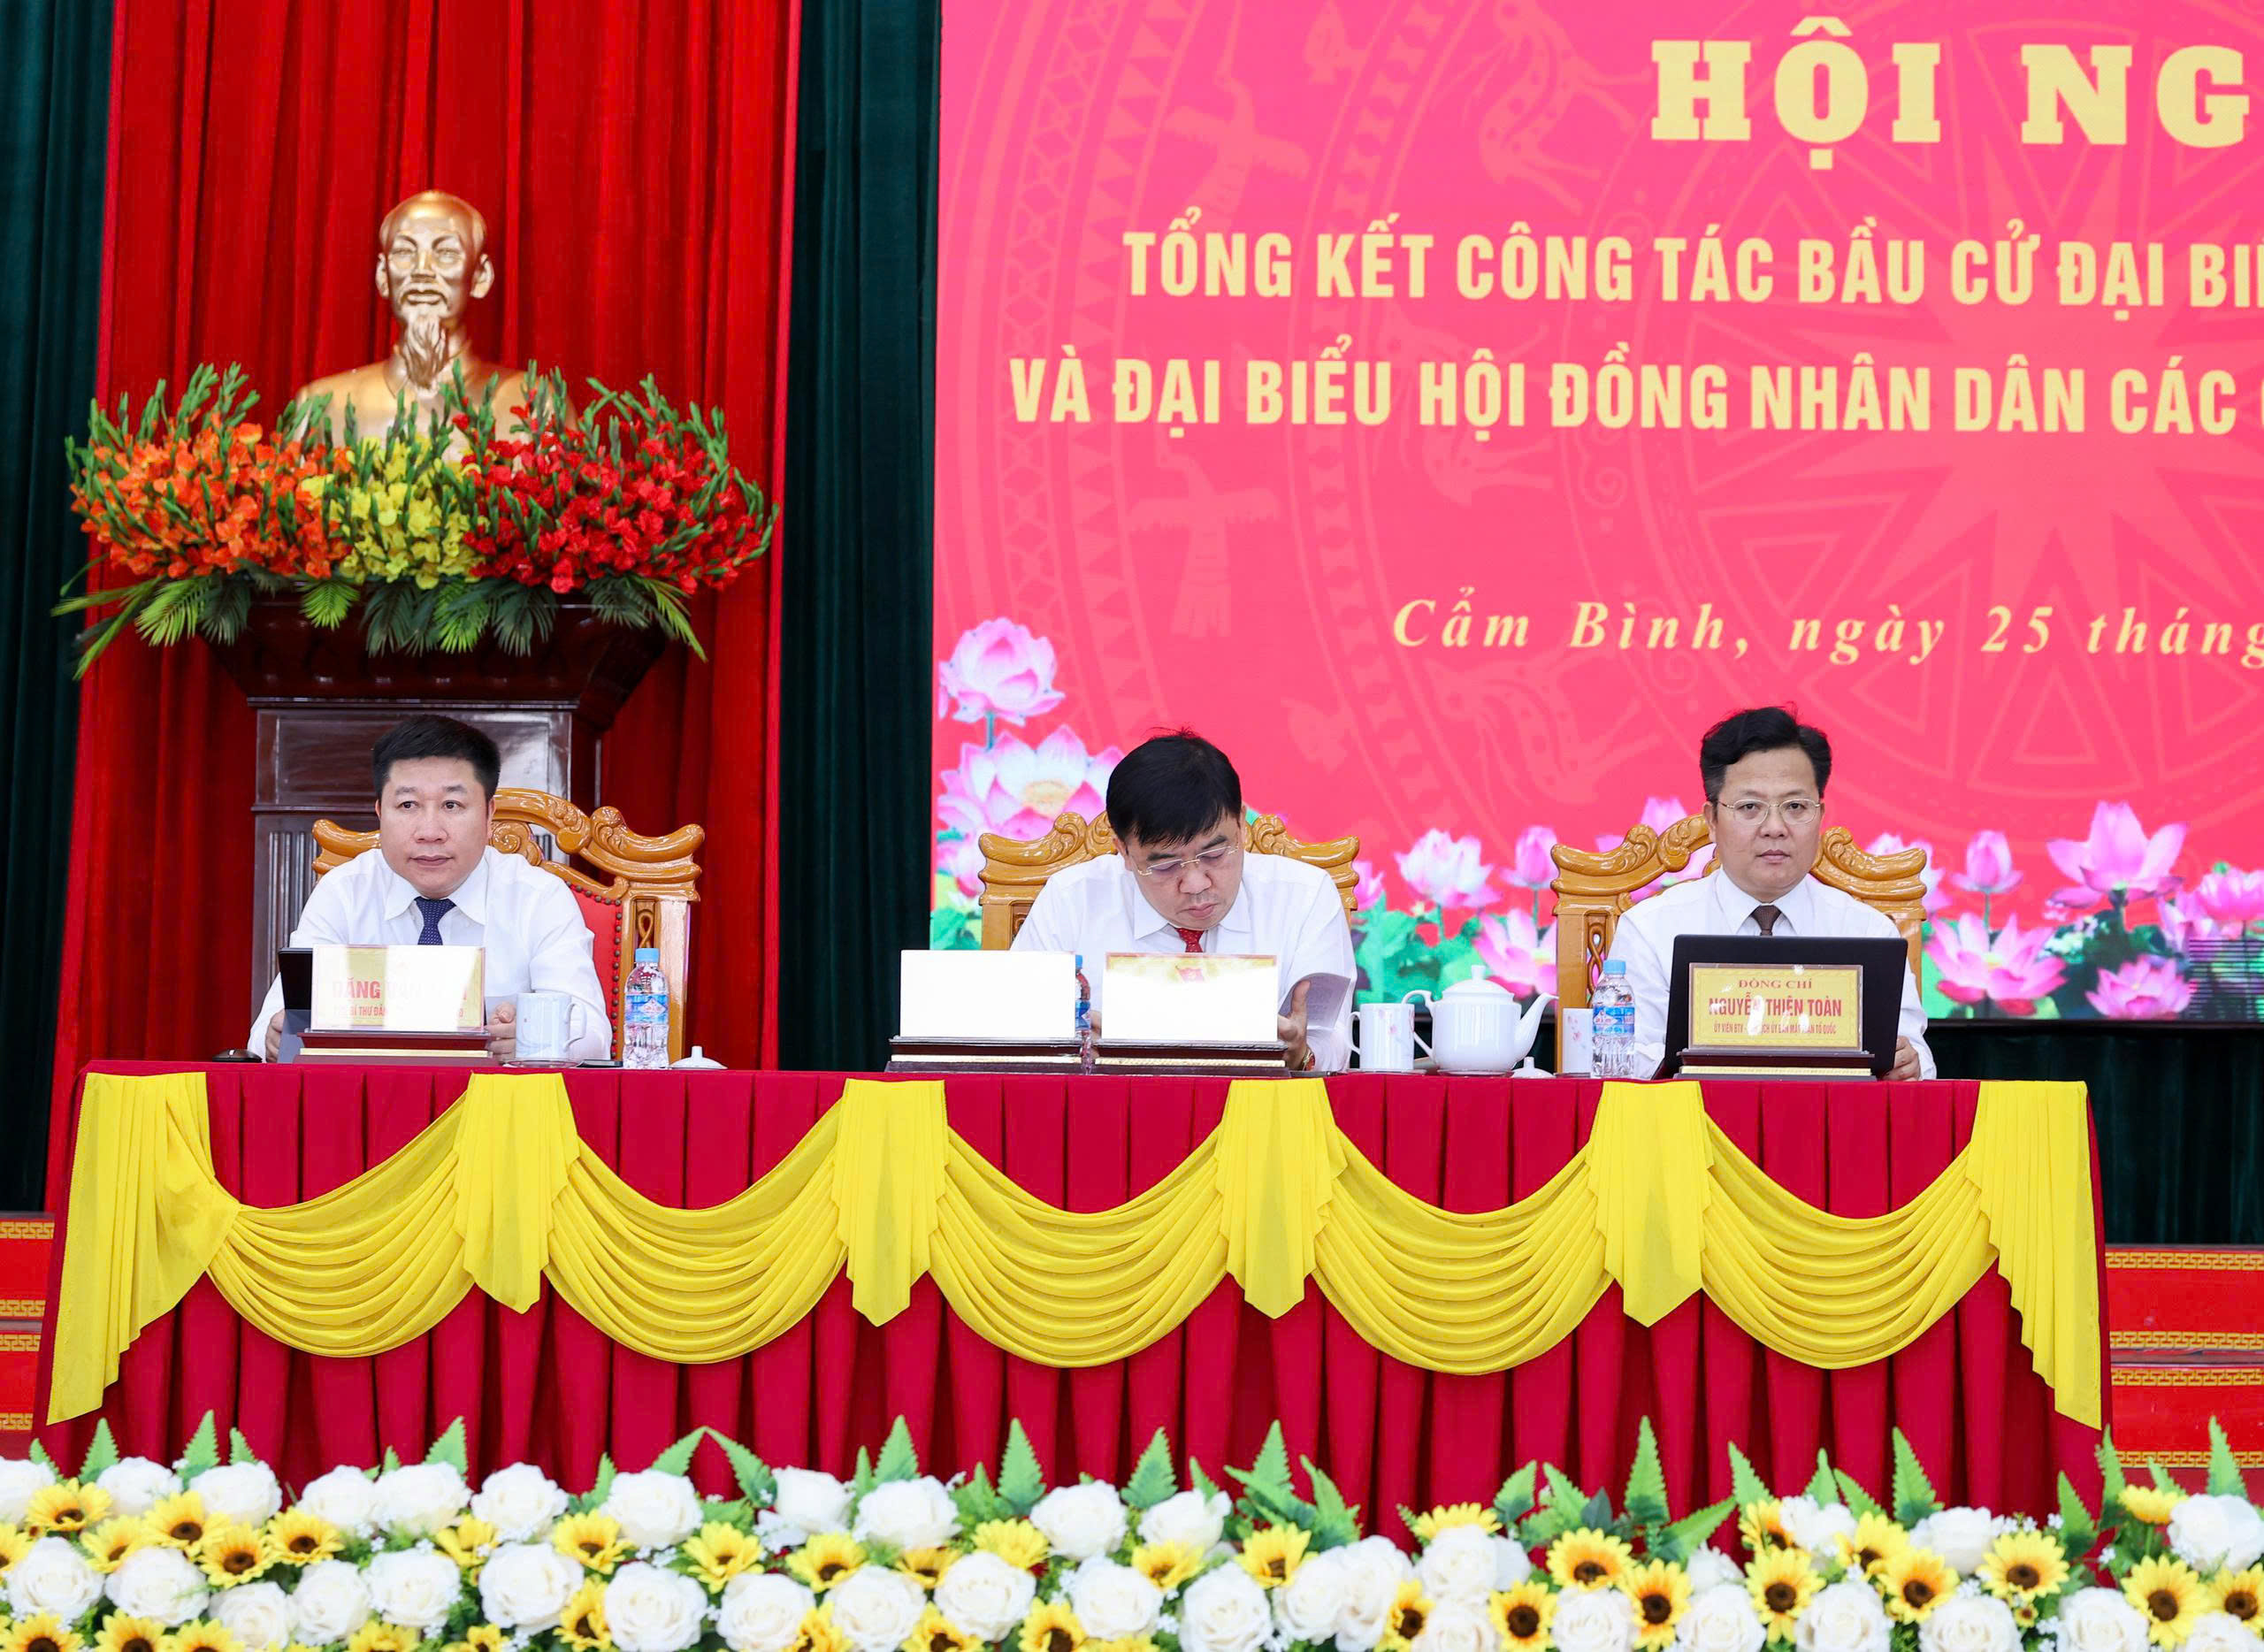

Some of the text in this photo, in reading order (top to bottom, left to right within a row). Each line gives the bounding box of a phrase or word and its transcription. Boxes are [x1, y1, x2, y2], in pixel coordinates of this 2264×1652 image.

[1650, 15, 1942, 172] HỘI
[1121, 204, 2264, 322] TỔNG KẾT CÔNG TÁC BẦU CỬ ĐẠI BI
[1008, 343, 1092, 424] VÀ
[1111, 357, 1221, 440] ĐẠI
[1245, 333, 1392, 426] BIỂU
[1419, 347, 1526, 443] HỘI
[1548, 340, 1728, 431] ĐỒNG
[1749, 351, 1931, 432] NHÂN
[1953, 352, 2086, 433] DÂN
[2109, 354, 2237, 436] CÁC
[1392, 585, 2264, 669] Cẩm Bình, ngày 25 tháng
[1786, 977, 1812, 989] CHÍ
